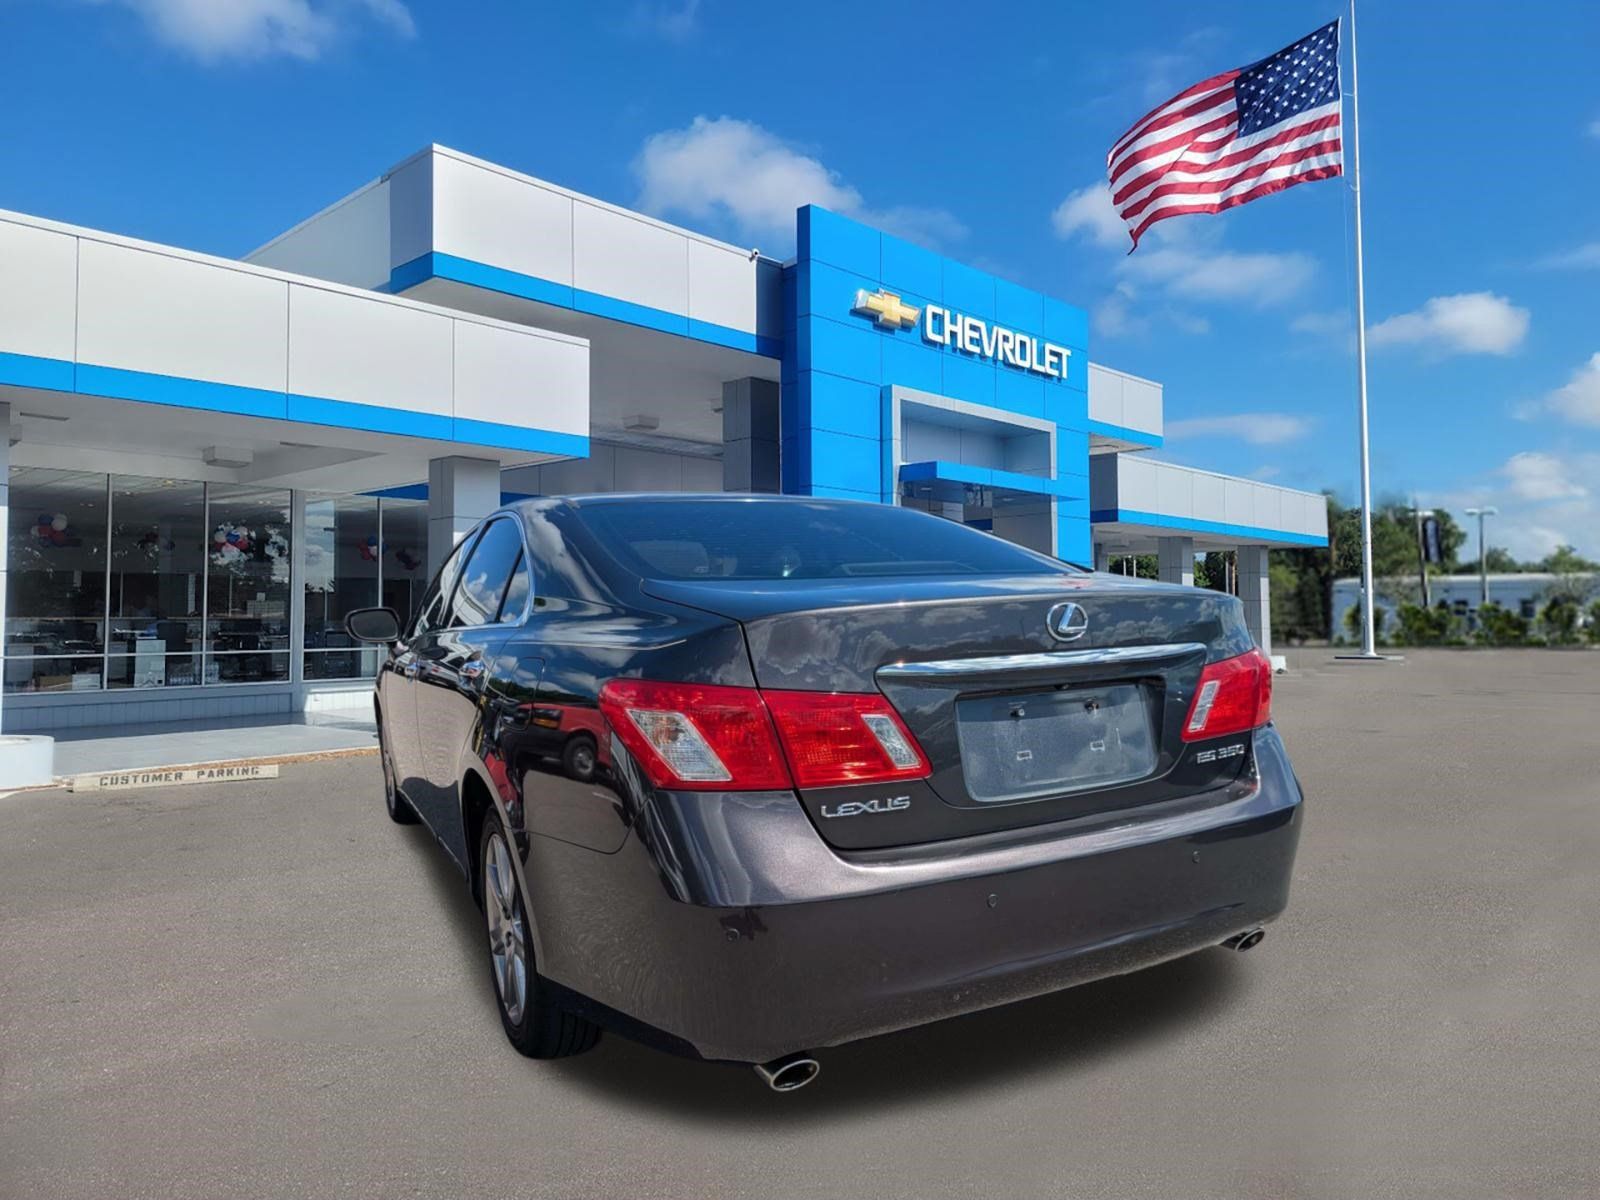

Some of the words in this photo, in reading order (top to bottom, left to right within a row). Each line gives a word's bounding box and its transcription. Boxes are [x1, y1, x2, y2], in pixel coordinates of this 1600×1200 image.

[926, 303, 1072, 379] CHEVROLET
[99, 772, 183, 786] CUSTOMER
[197, 766, 259, 779] PARKING
[821, 796, 910, 818] LEXUS
